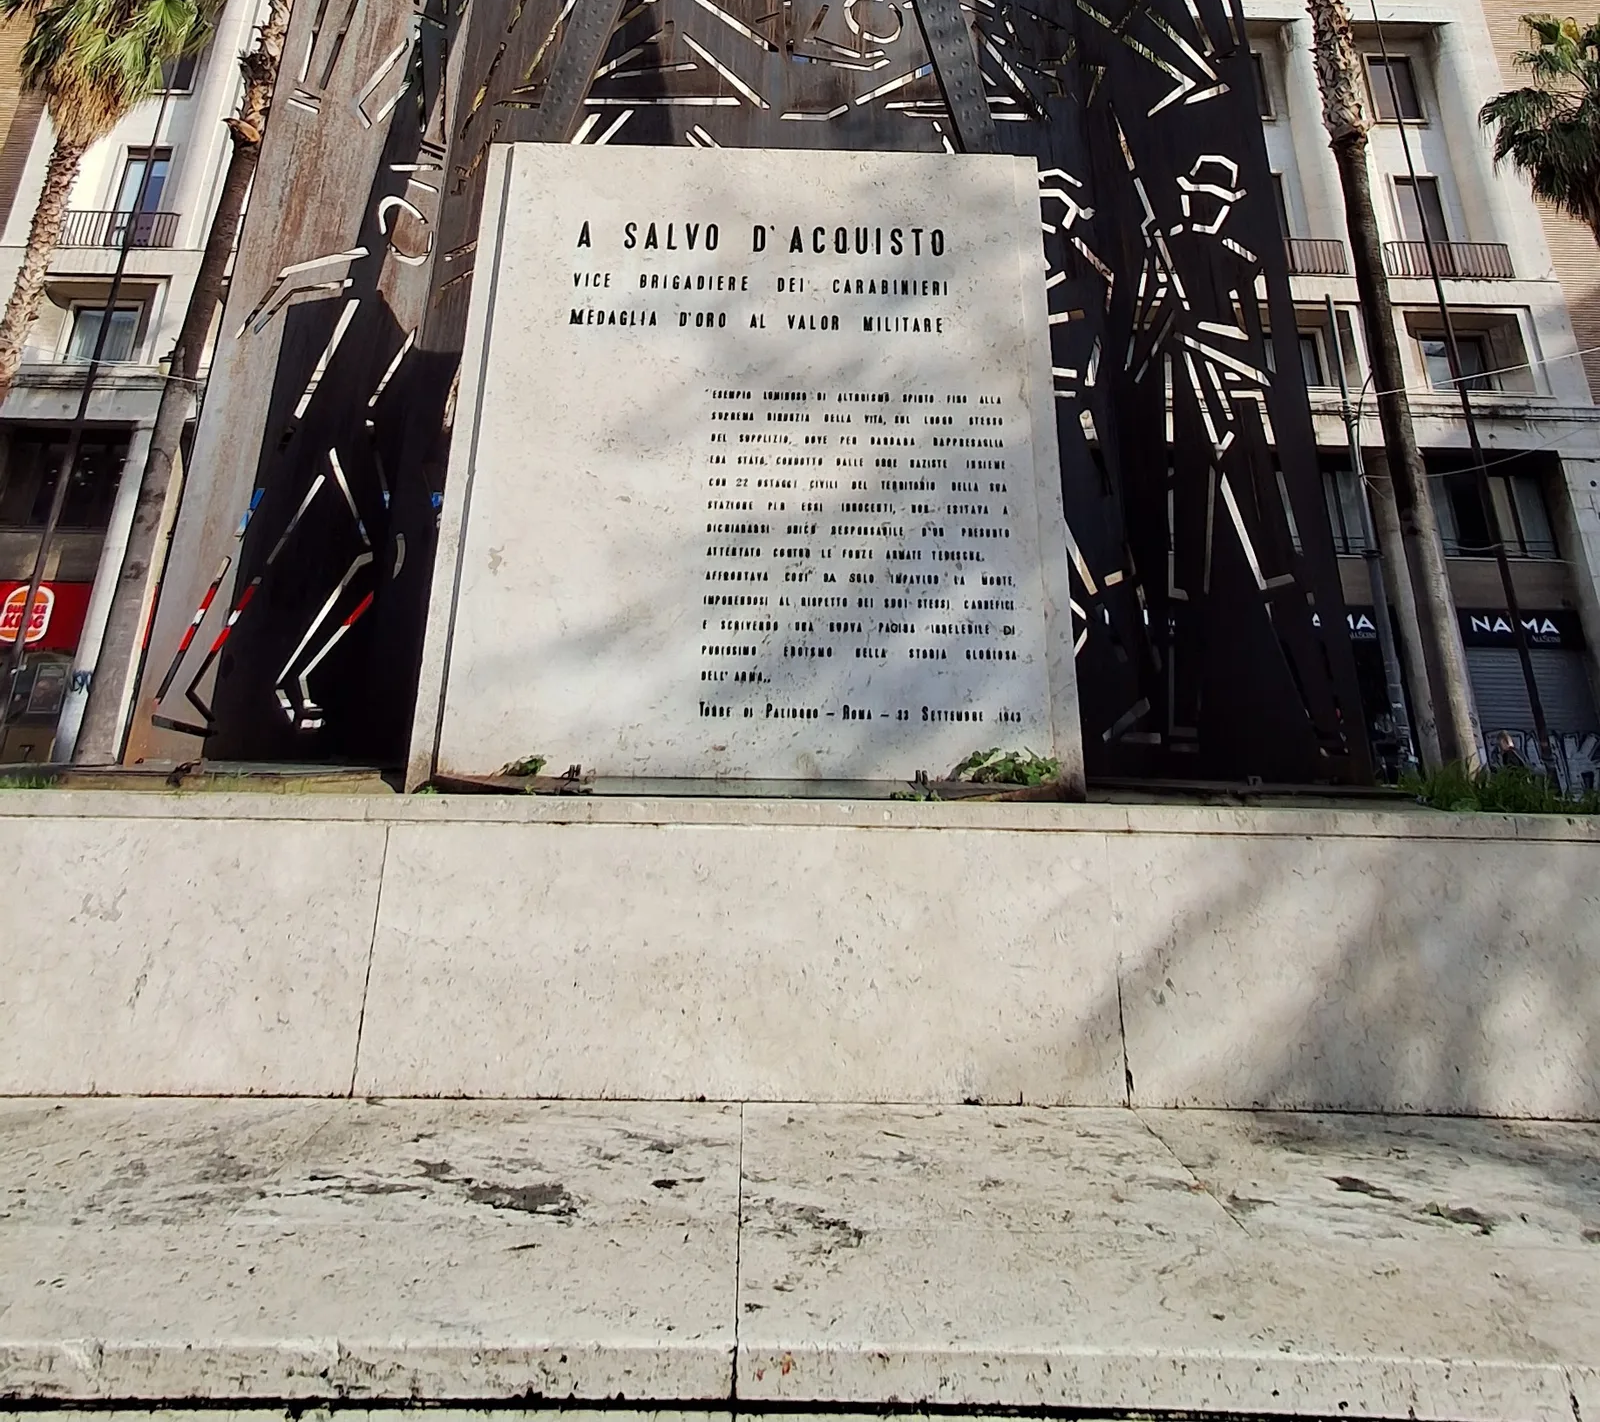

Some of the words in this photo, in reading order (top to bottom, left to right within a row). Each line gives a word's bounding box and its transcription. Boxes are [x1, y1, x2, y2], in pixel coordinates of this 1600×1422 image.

[577, 221, 591, 248] A
[624, 222, 718, 250] SALVO
[753, 225, 944, 256] D'ACQUISTO
[574, 273, 610, 288] VICE
[640, 274, 748, 291] BRIGADIERE
[777, 278, 803, 292] DEI
[833, 279, 947, 296] CARABINIERI
[569, 309, 656, 327] MEDAGLIA
[679, 312, 726, 328] D'ORO
[750, 314, 766, 328] AL
[788, 315, 839, 330] VALOR
[864, 316, 942, 333] MILITARE
[947, 395, 966, 403] FINO
[980, 396, 1001, 404] ALLA
[711, 412, 753, 421] SUPREMA
[824, 414, 851, 423] DELLA
[865, 415, 886, 425] VITA,
[895, 415, 909, 424] SUL
[969, 417, 1002, 425] STESSO
[711, 433, 726, 442] DEL
[805, 436, 827, 444] DOVE
[840, 436, 856, 445] PER
[837, 458, 863, 467] DALLE
[910, 459, 947, 468] NAZISTE
[967, 460, 1005, 469] INSIEME
[736, 478, 748, 487] 22
[758, 479, 797, 488] OSTAGGI
[810, 480, 837, 490] CIVILI
[852, 481, 867, 490] DEL
[952, 482, 978, 492] DELLA
[708, 501, 752, 510] STAZIONE
[947, 505, 988, 514] ESITAVA
[1003, 506, 1007, 514] A
[707, 544, 760, 557] ATTENTATO
[822, 549, 831, 558] LE
[886, 550, 921, 560] ARMATE
[824, 573, 836, 582] DA
[849, 573, 874, 584] SOLO
[779, 596, 790, 606] AL
[801, 597, 847, 607] RISPETTO
[7, 604, 47, 614] BURER
[703, 620, 707, 629] E
[721, 620, 778, 631] SCRIVENDO
[879, 621, 915, 633] PAGINA
[1003, 625, 1015, 635] DI
[1470, 615, 1561, 634] NAMA
[702, 645, 756, 656] PURISSIMO
[784, 646, 832, 659] EROISMO
[909, 649, 946, 660] STORIA
